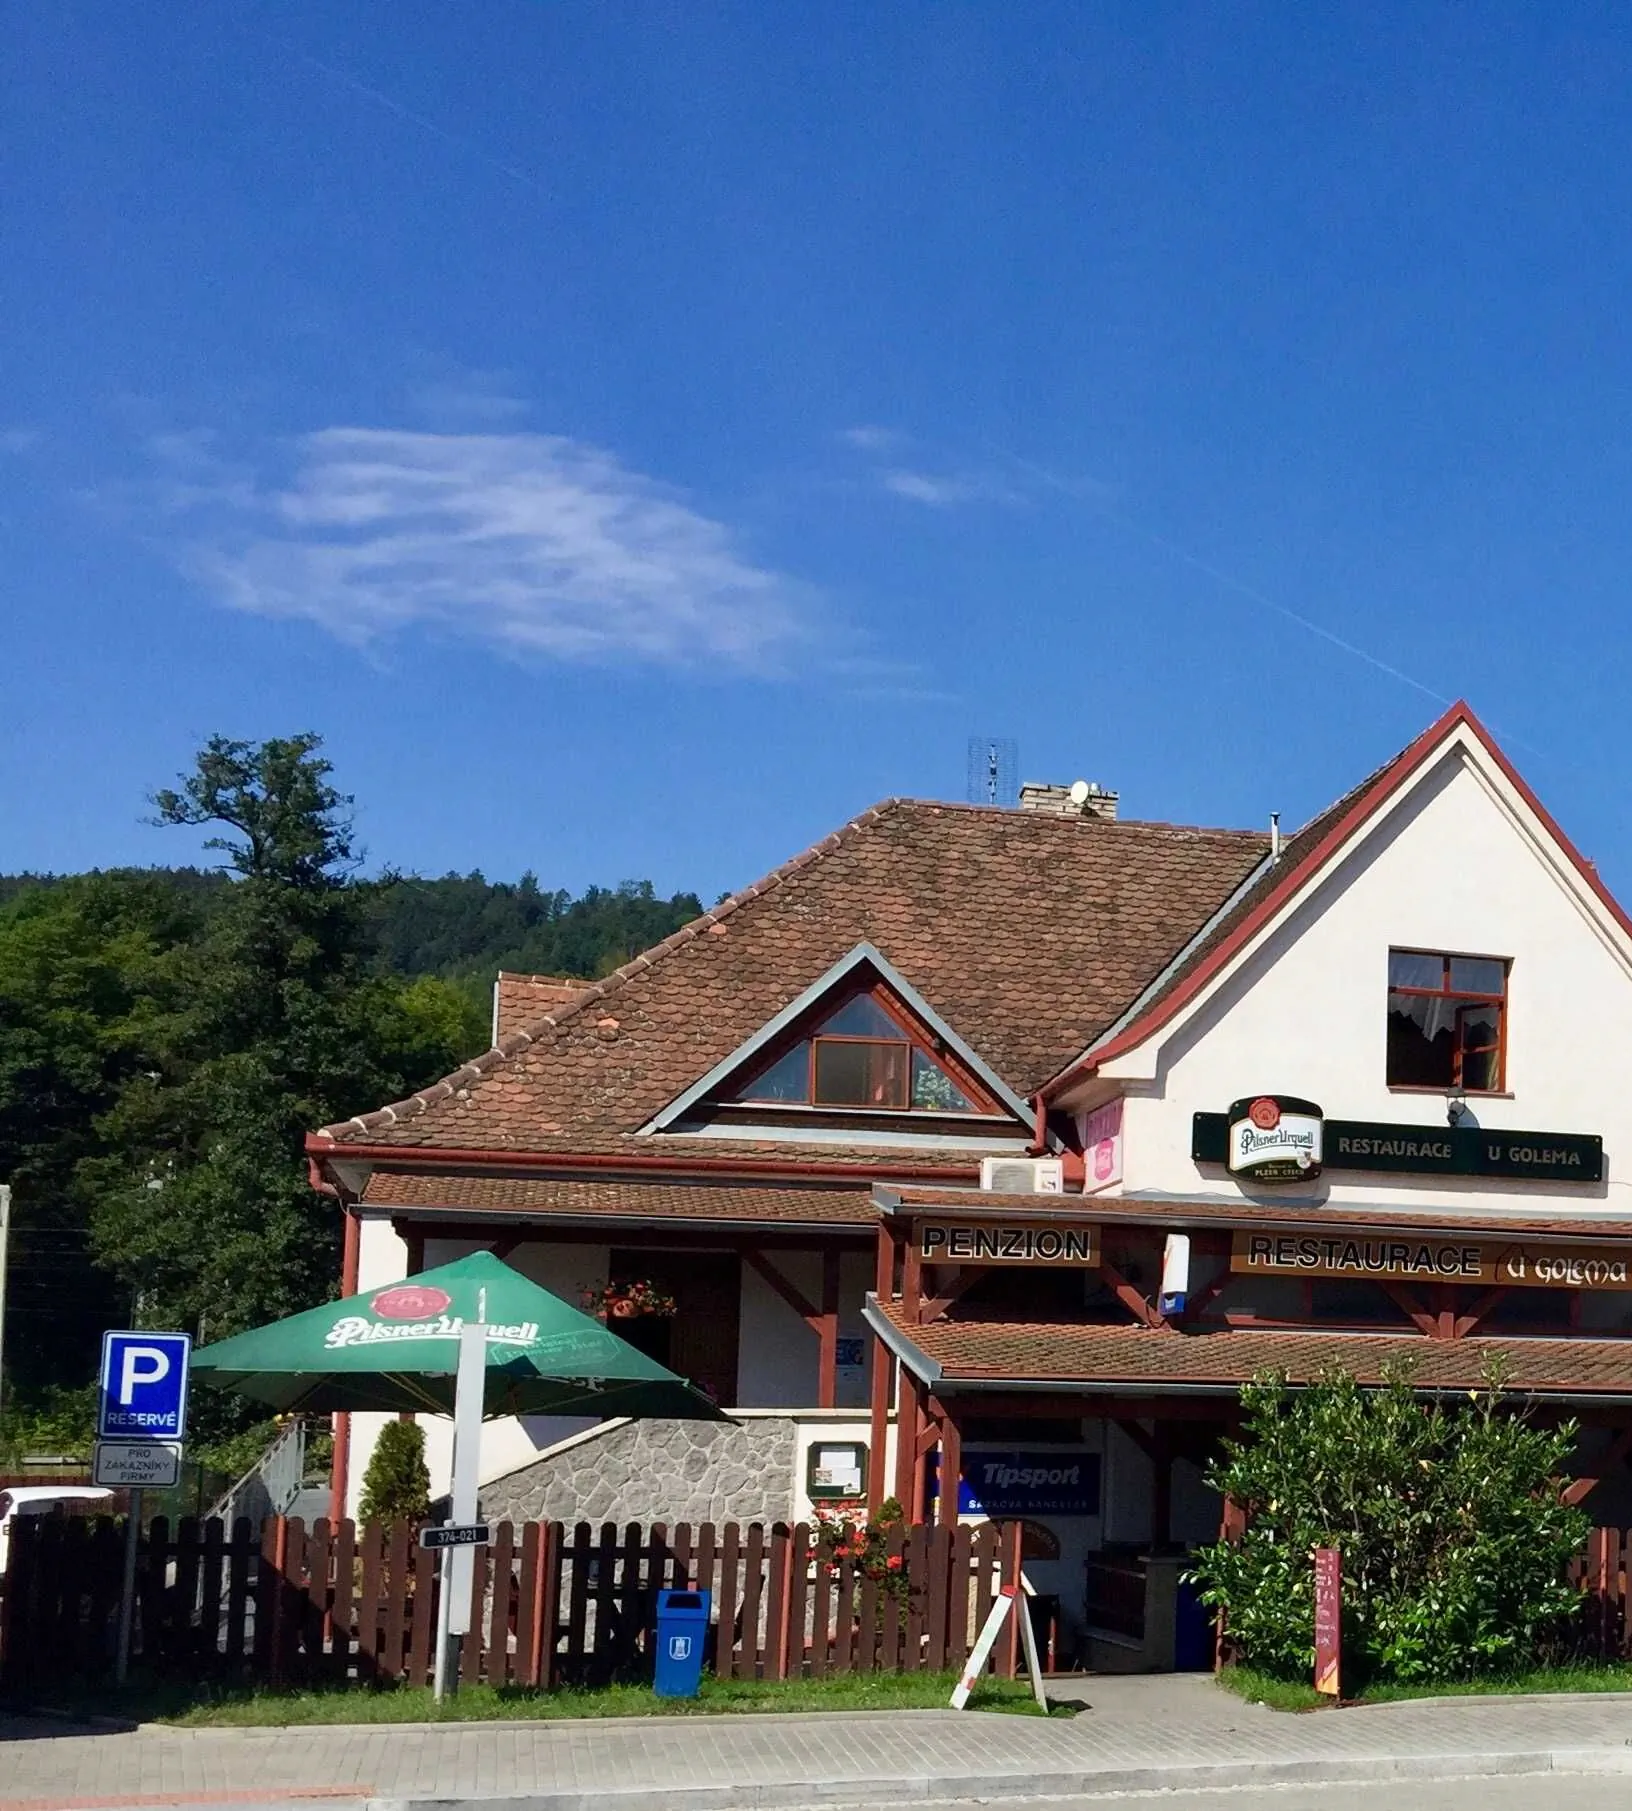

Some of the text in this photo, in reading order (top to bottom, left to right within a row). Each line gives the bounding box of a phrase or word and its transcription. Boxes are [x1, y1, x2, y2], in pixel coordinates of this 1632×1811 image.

[1241, 1128, 1314, 1155] Pilsner Urquell
[1338, 1136, 1582, 1165] RESTAURACE U GOLEMA
[921, 1225, 1091, 1261] PENZION
[1247, 1236, 1482, 1276] RESTAURACE
[324, 1314, 539, 1349] Pilsner Uuell
[120, 1346, 169, 1405] P
[984, 1463, 1080, 1489] Tipsport
[438, 1529, 477, 1544] 374-021
